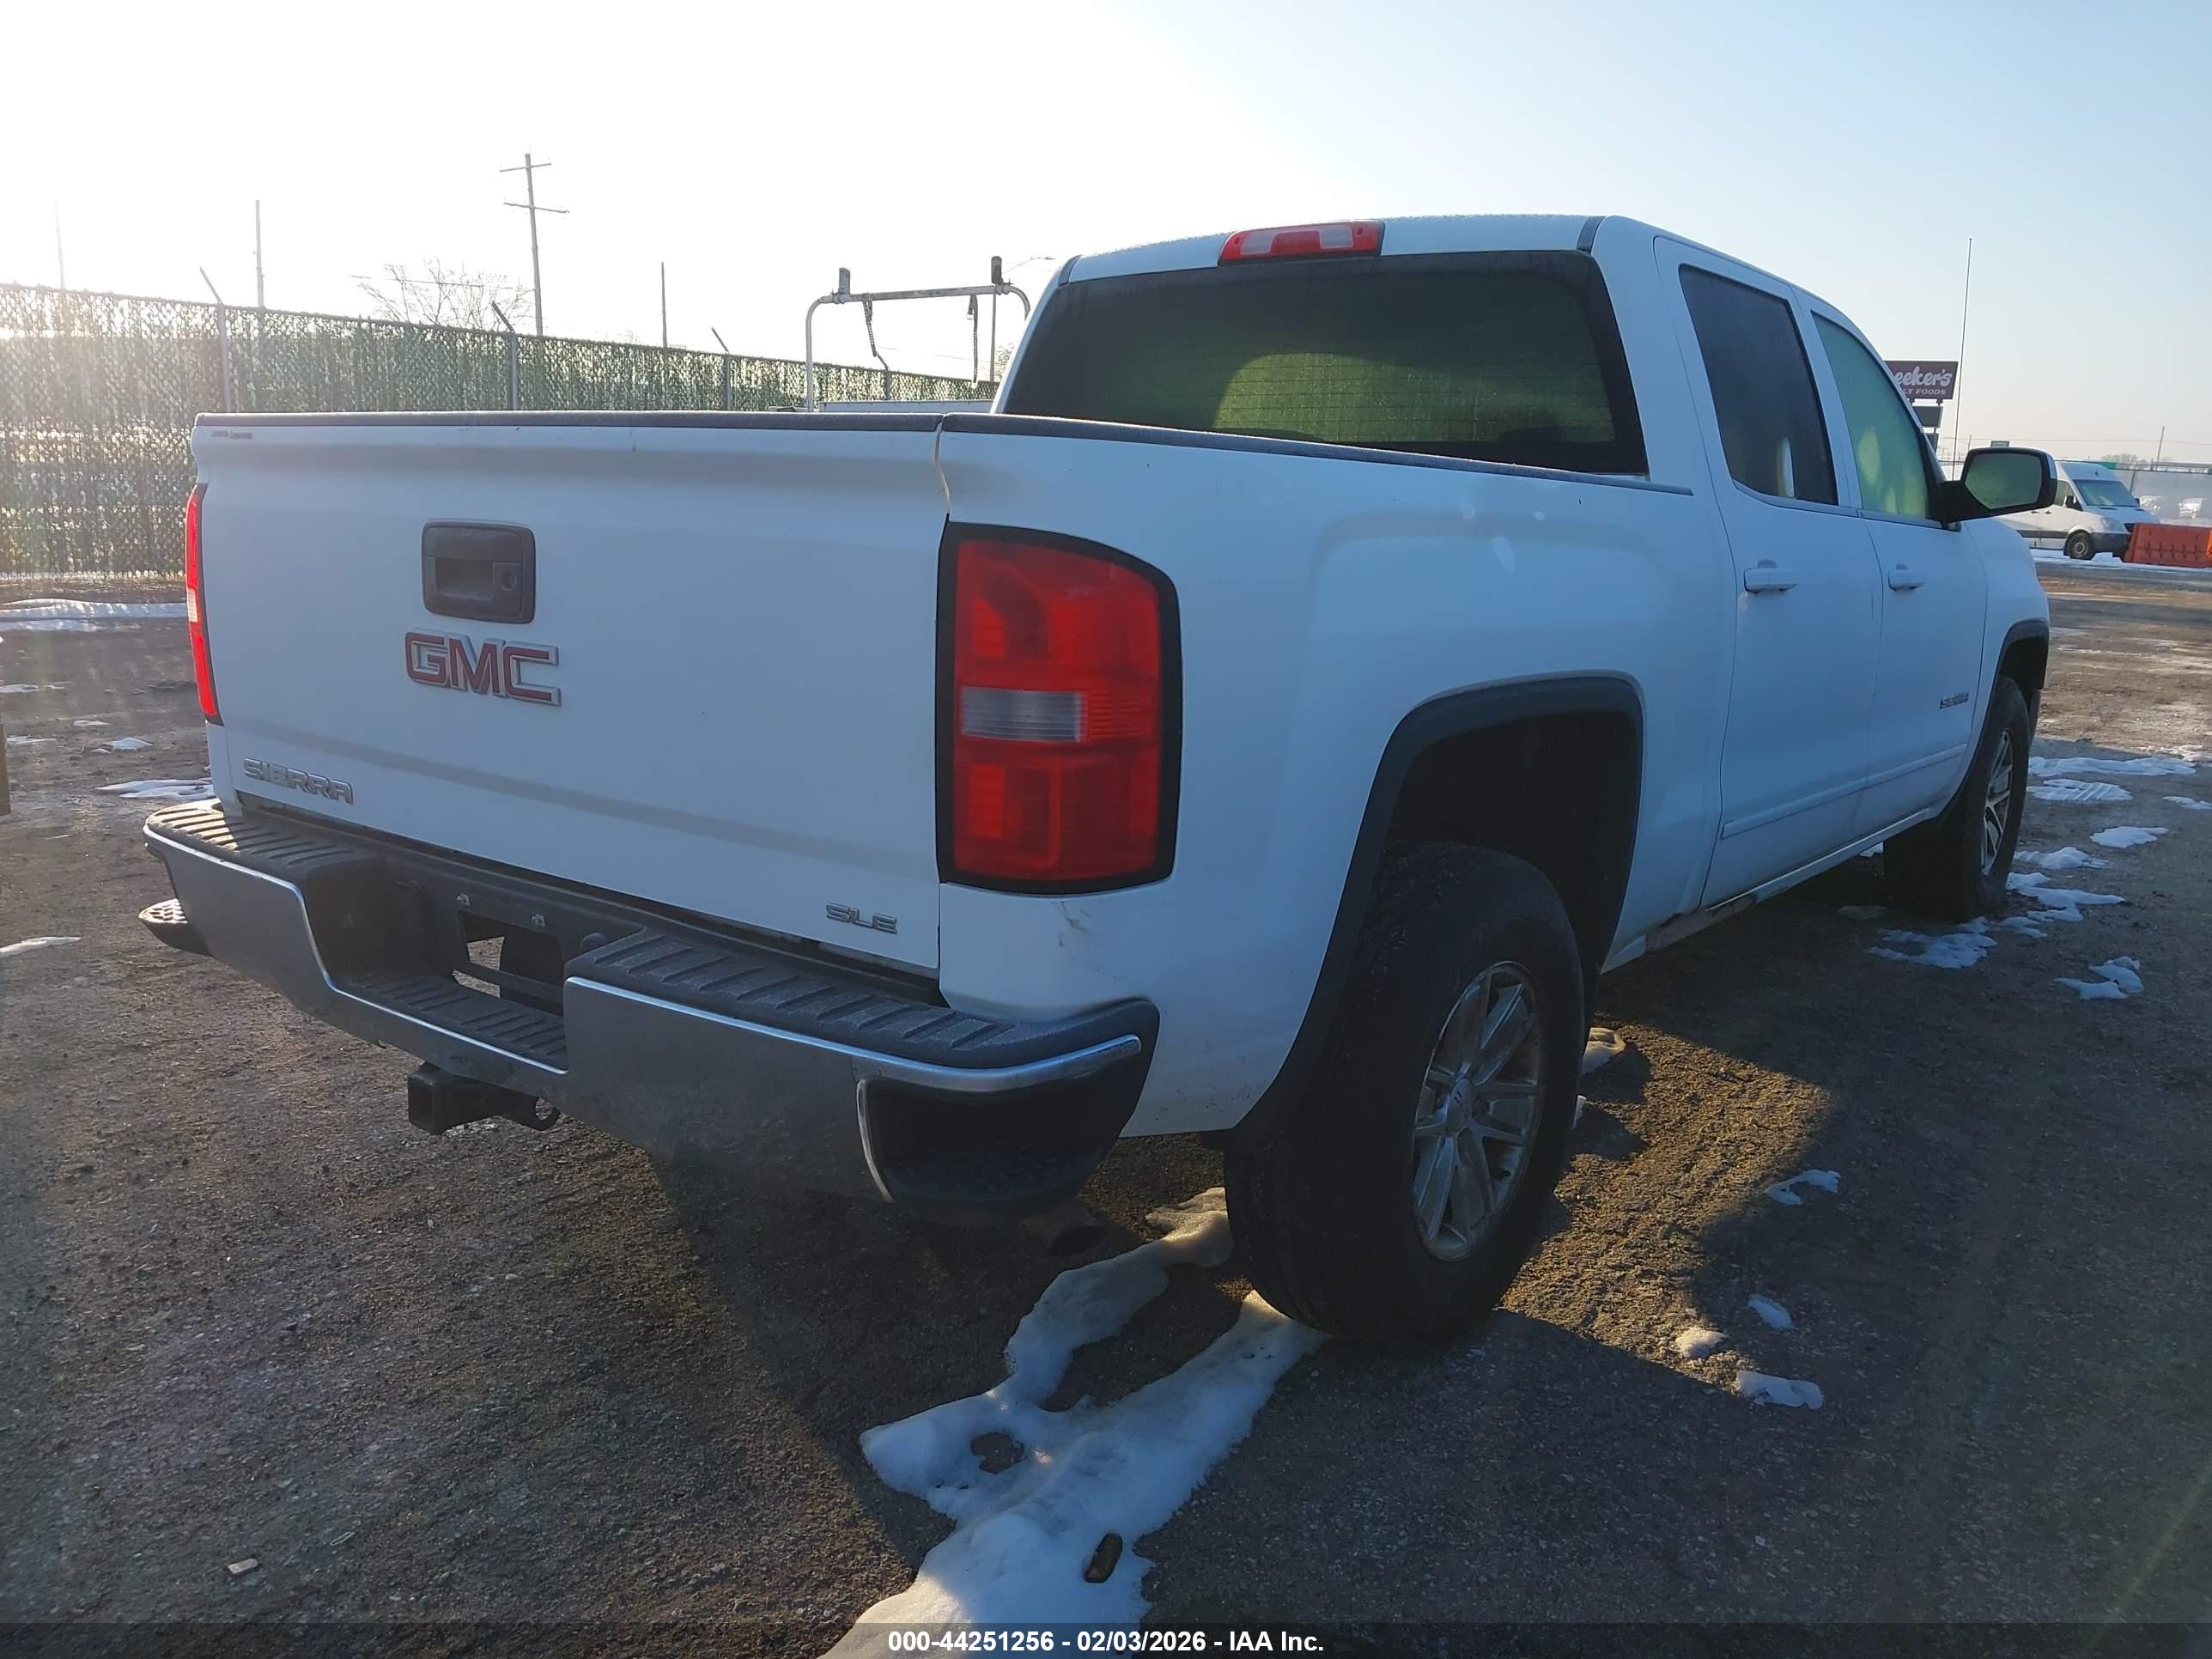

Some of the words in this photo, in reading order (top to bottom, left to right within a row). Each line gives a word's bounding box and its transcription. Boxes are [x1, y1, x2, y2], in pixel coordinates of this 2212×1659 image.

[404, 628, 562, 708] GMC
[243, 757, 354, 805] SIERRA
[825, 902, 898, 934] SLE
